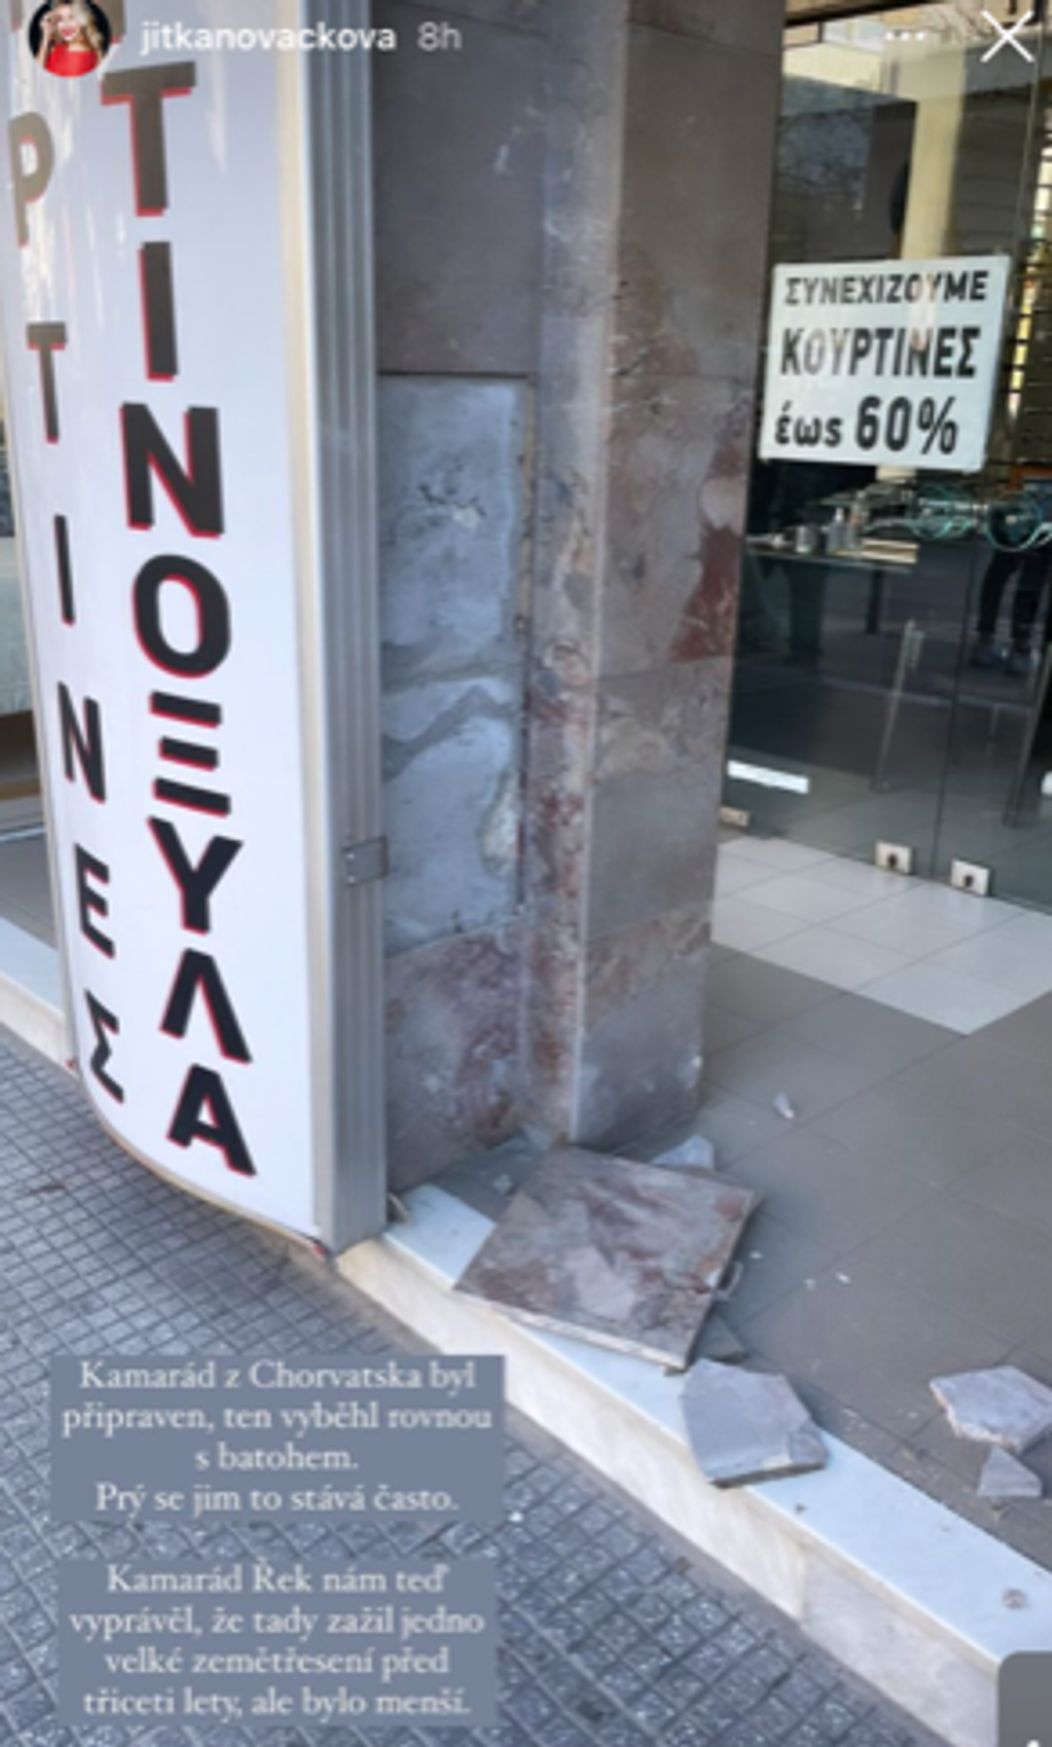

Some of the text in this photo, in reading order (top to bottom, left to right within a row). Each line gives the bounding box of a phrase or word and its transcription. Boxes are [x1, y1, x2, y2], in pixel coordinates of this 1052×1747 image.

[785, 269, 989, 305] ΣΥΝΕΧΙΖΟΥΜΕ
[780, 325, 981, 379] ΚΟΥΡΤΙΝΕΣ
[855, 394, 959, 456] 60%
[8, 0, 124, 1104] ΡΤΙΝΕΣ
[98, 0, 257, 1177] ΤΙΝΟΞΥΛΑ
